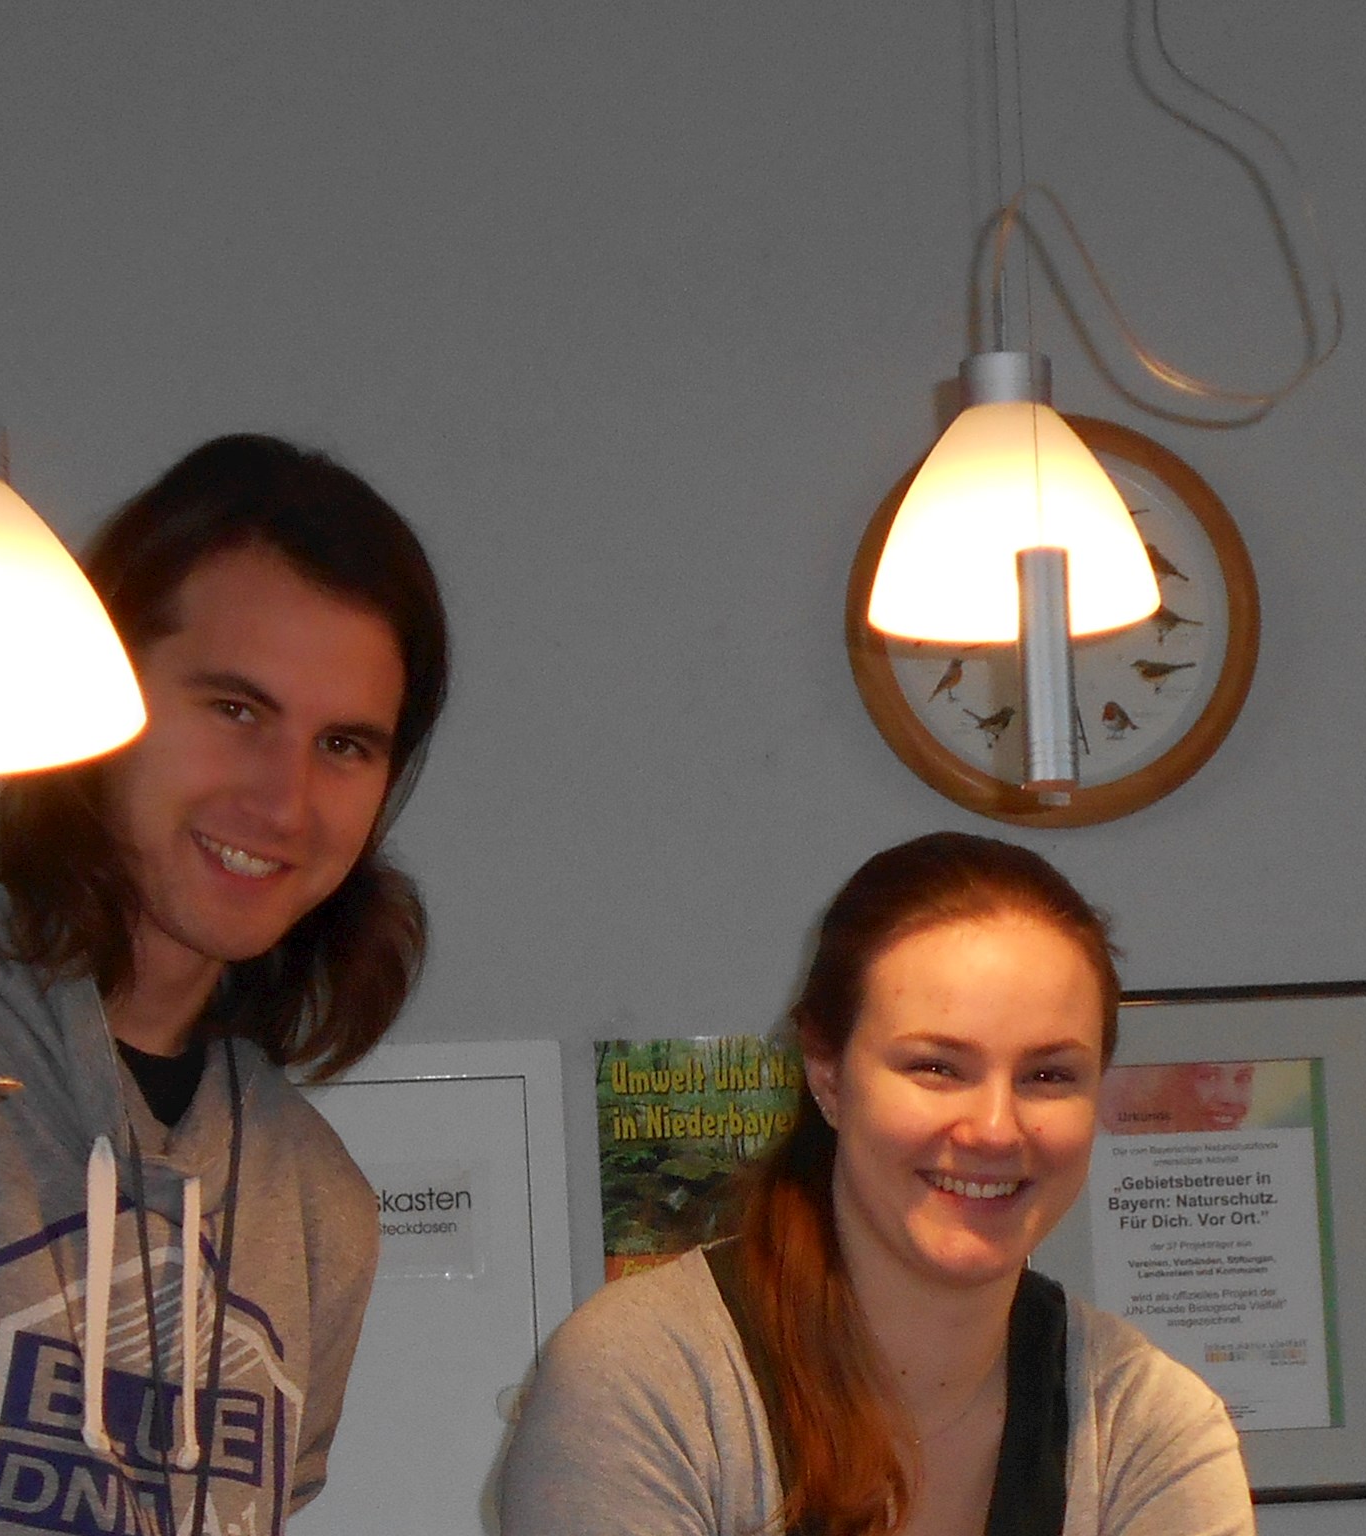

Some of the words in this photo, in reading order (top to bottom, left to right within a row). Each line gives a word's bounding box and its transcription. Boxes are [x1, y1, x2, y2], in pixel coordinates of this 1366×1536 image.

[611, 1056, 706, 1096] Umwelt
[714, 1057, 762, 1092] und
[614, 1107, 639, 1141] in
[1114, 1173, 1253, 1194] „Gebietsbetreuer
[1255, 1171, 1272, 1186] in
[1108, 1197, 1171, 1213] Bayern:
[1176, 1191, 1279, 1208] Naturschutz.
[1119, 1214, 1148, 1230] Für
[1151, 1212, 1193, 1229] Dich.
[1197, 1212, 1226, 1227] Vor
[1196, 1267, 1214, 1276] und
